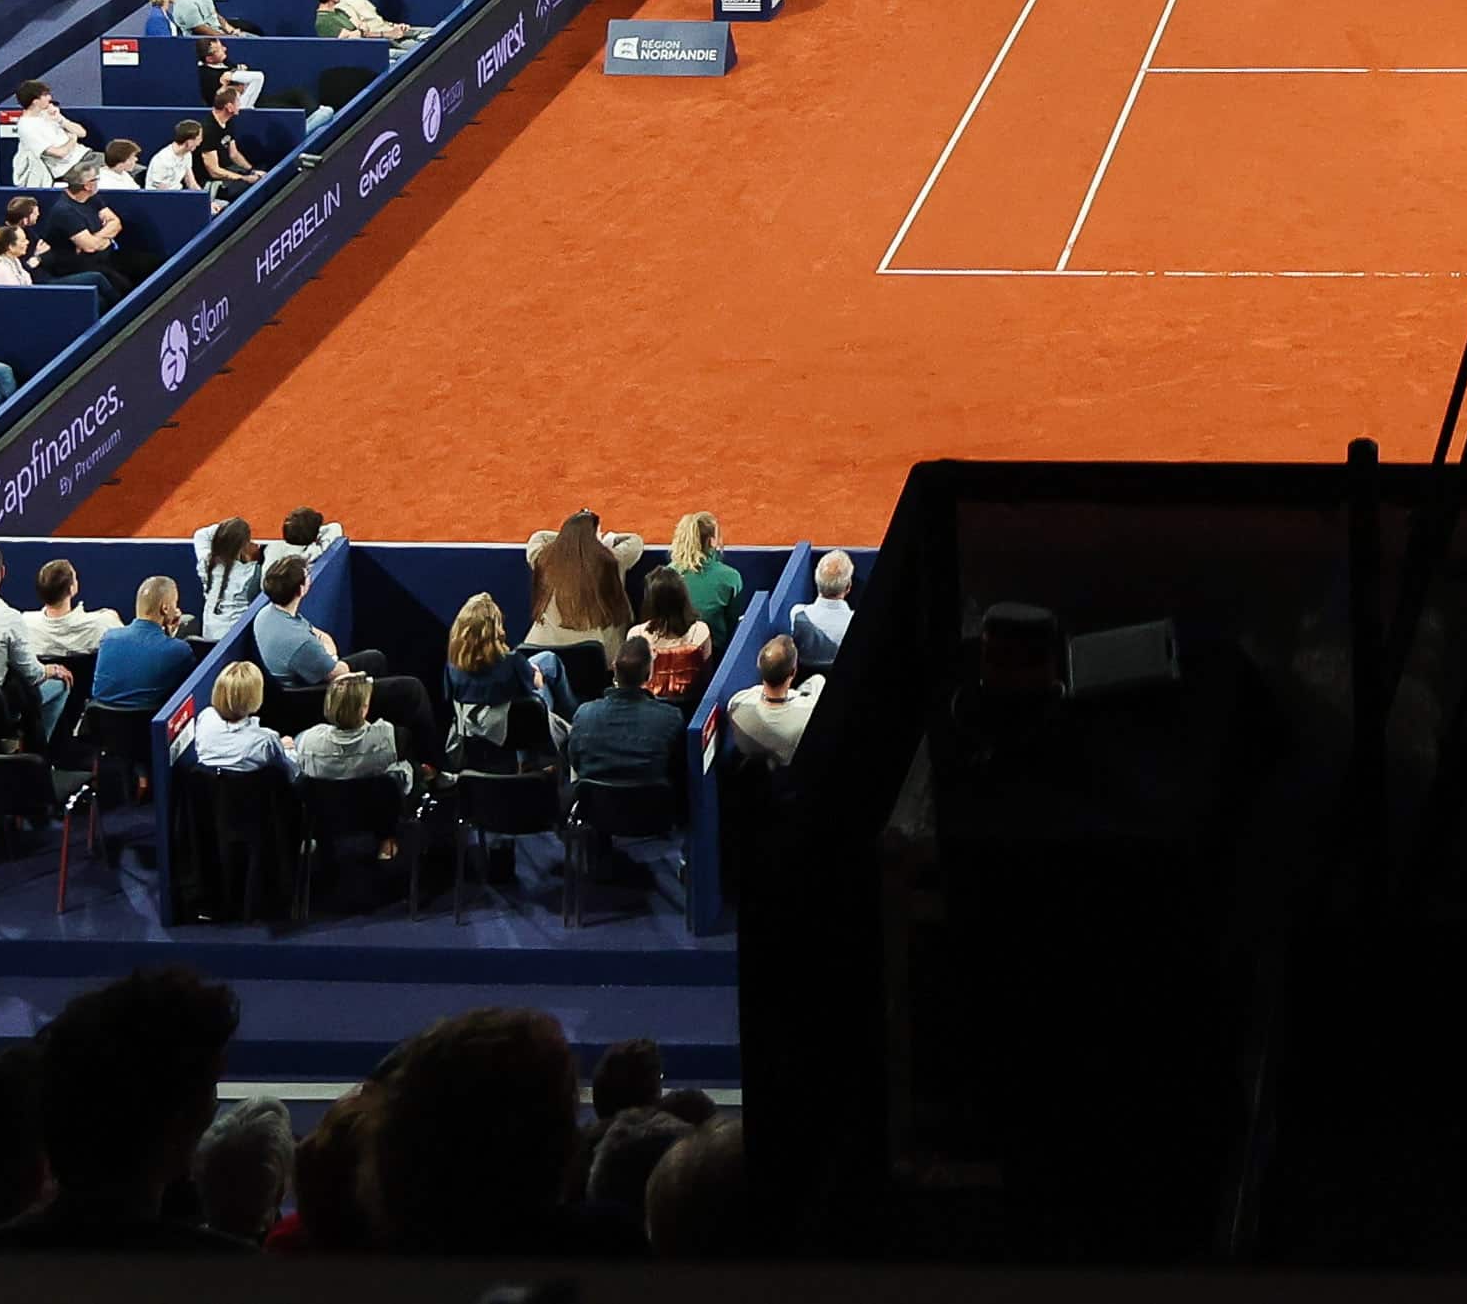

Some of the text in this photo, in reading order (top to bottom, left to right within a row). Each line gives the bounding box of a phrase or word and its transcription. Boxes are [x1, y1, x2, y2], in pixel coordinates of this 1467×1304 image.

[639, 50, 717, 62] NORMANDIE
[641, 38, 681, 48] RÉGION
[256, 182, 341, 284] HERBELIN
[191, 296, 229, 345] Silam
[75, 429, 122, 481] Premium
